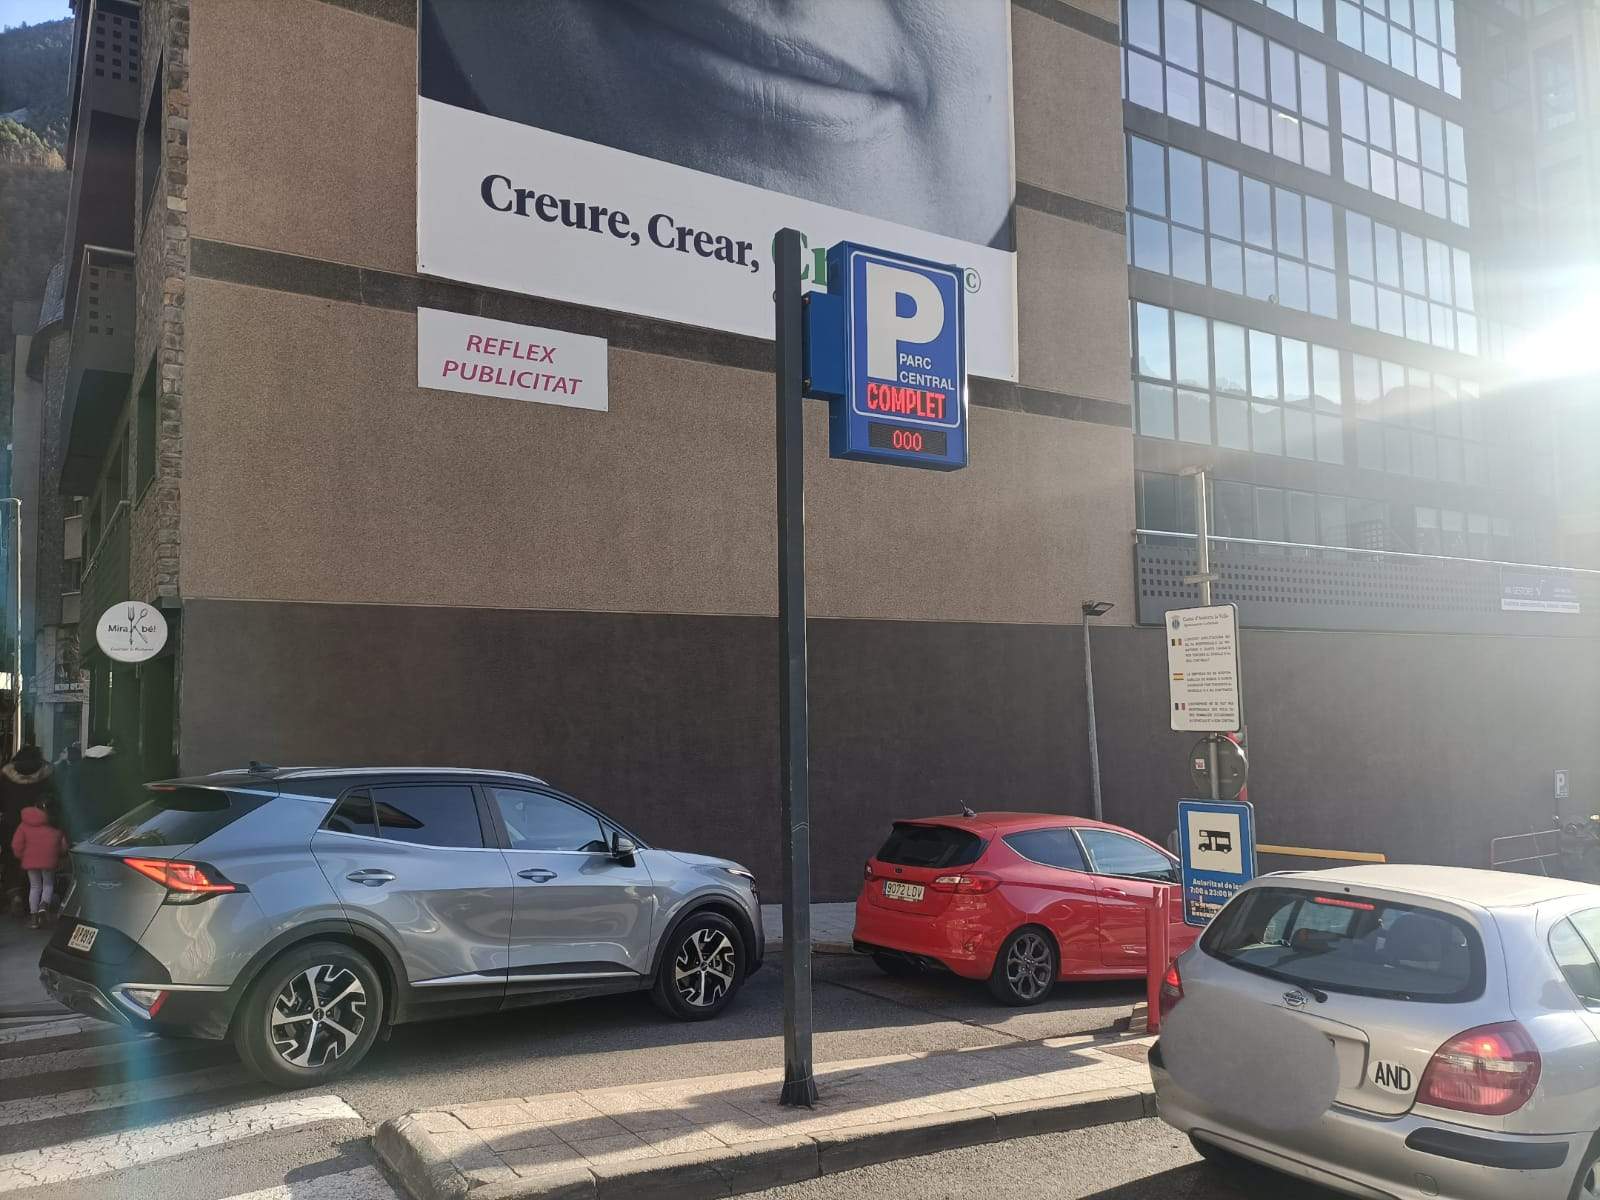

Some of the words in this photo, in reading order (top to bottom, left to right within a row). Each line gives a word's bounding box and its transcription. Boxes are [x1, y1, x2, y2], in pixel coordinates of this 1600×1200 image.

[481, 174, 640, 247] Creure,
[648, 213, 760, 273] Crear,
[866, 262, 945, 382] P
[466, 334, 557, 364] REFLEX
[900, 353, 932, 370] PARC
[442, 360, 583, 395] PUBLICITAT
[900, 371, 956, 391] CENTRAL
[866, 383, 946, 419] COMPLET
[892, 430, 923, 451] 000
[886, 882, 906, 898] 9072
[1374, 1061, 1411, 1091] AND
